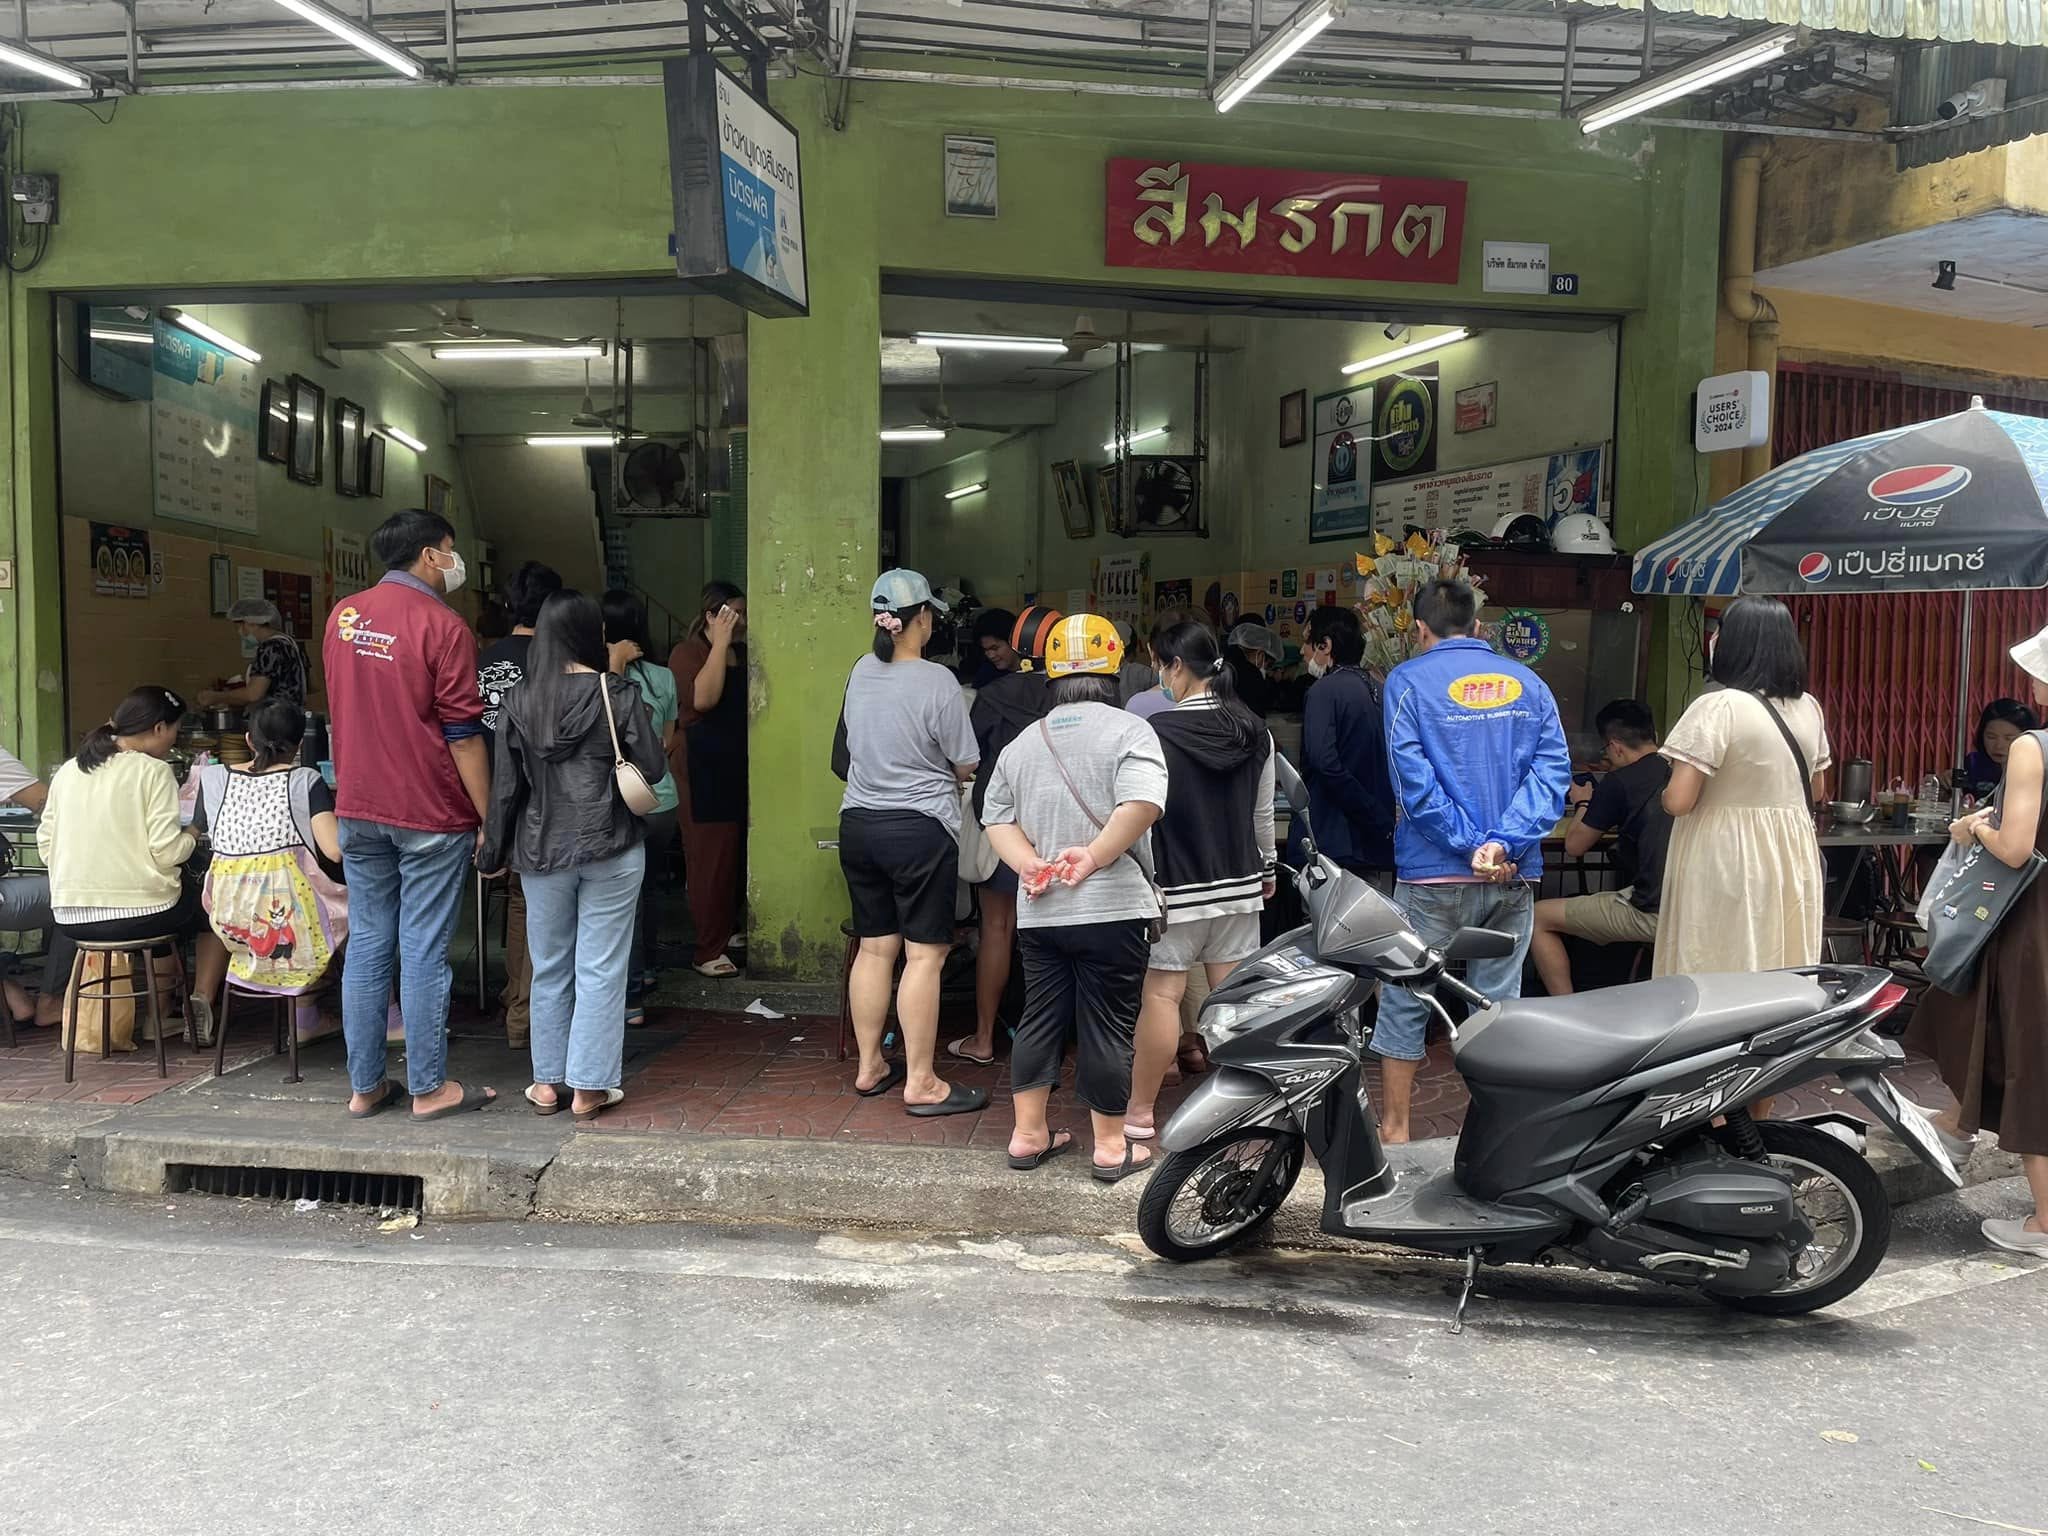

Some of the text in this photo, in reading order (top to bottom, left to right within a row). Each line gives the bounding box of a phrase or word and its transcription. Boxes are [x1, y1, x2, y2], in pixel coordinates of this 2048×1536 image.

[728, 167, 769, 220] มิตรผล
[1133, 161, 1447, 259] สีมรกต
[1556, 276, 1573, 292] 80
[1706, 410, 1740, 424] CHOICE
[1713, 422, 1733, 433] 2024
[1447, 714, 1486, 722] AUTOMOTIVE
[1512, 709, 1531, 719] PARTS
